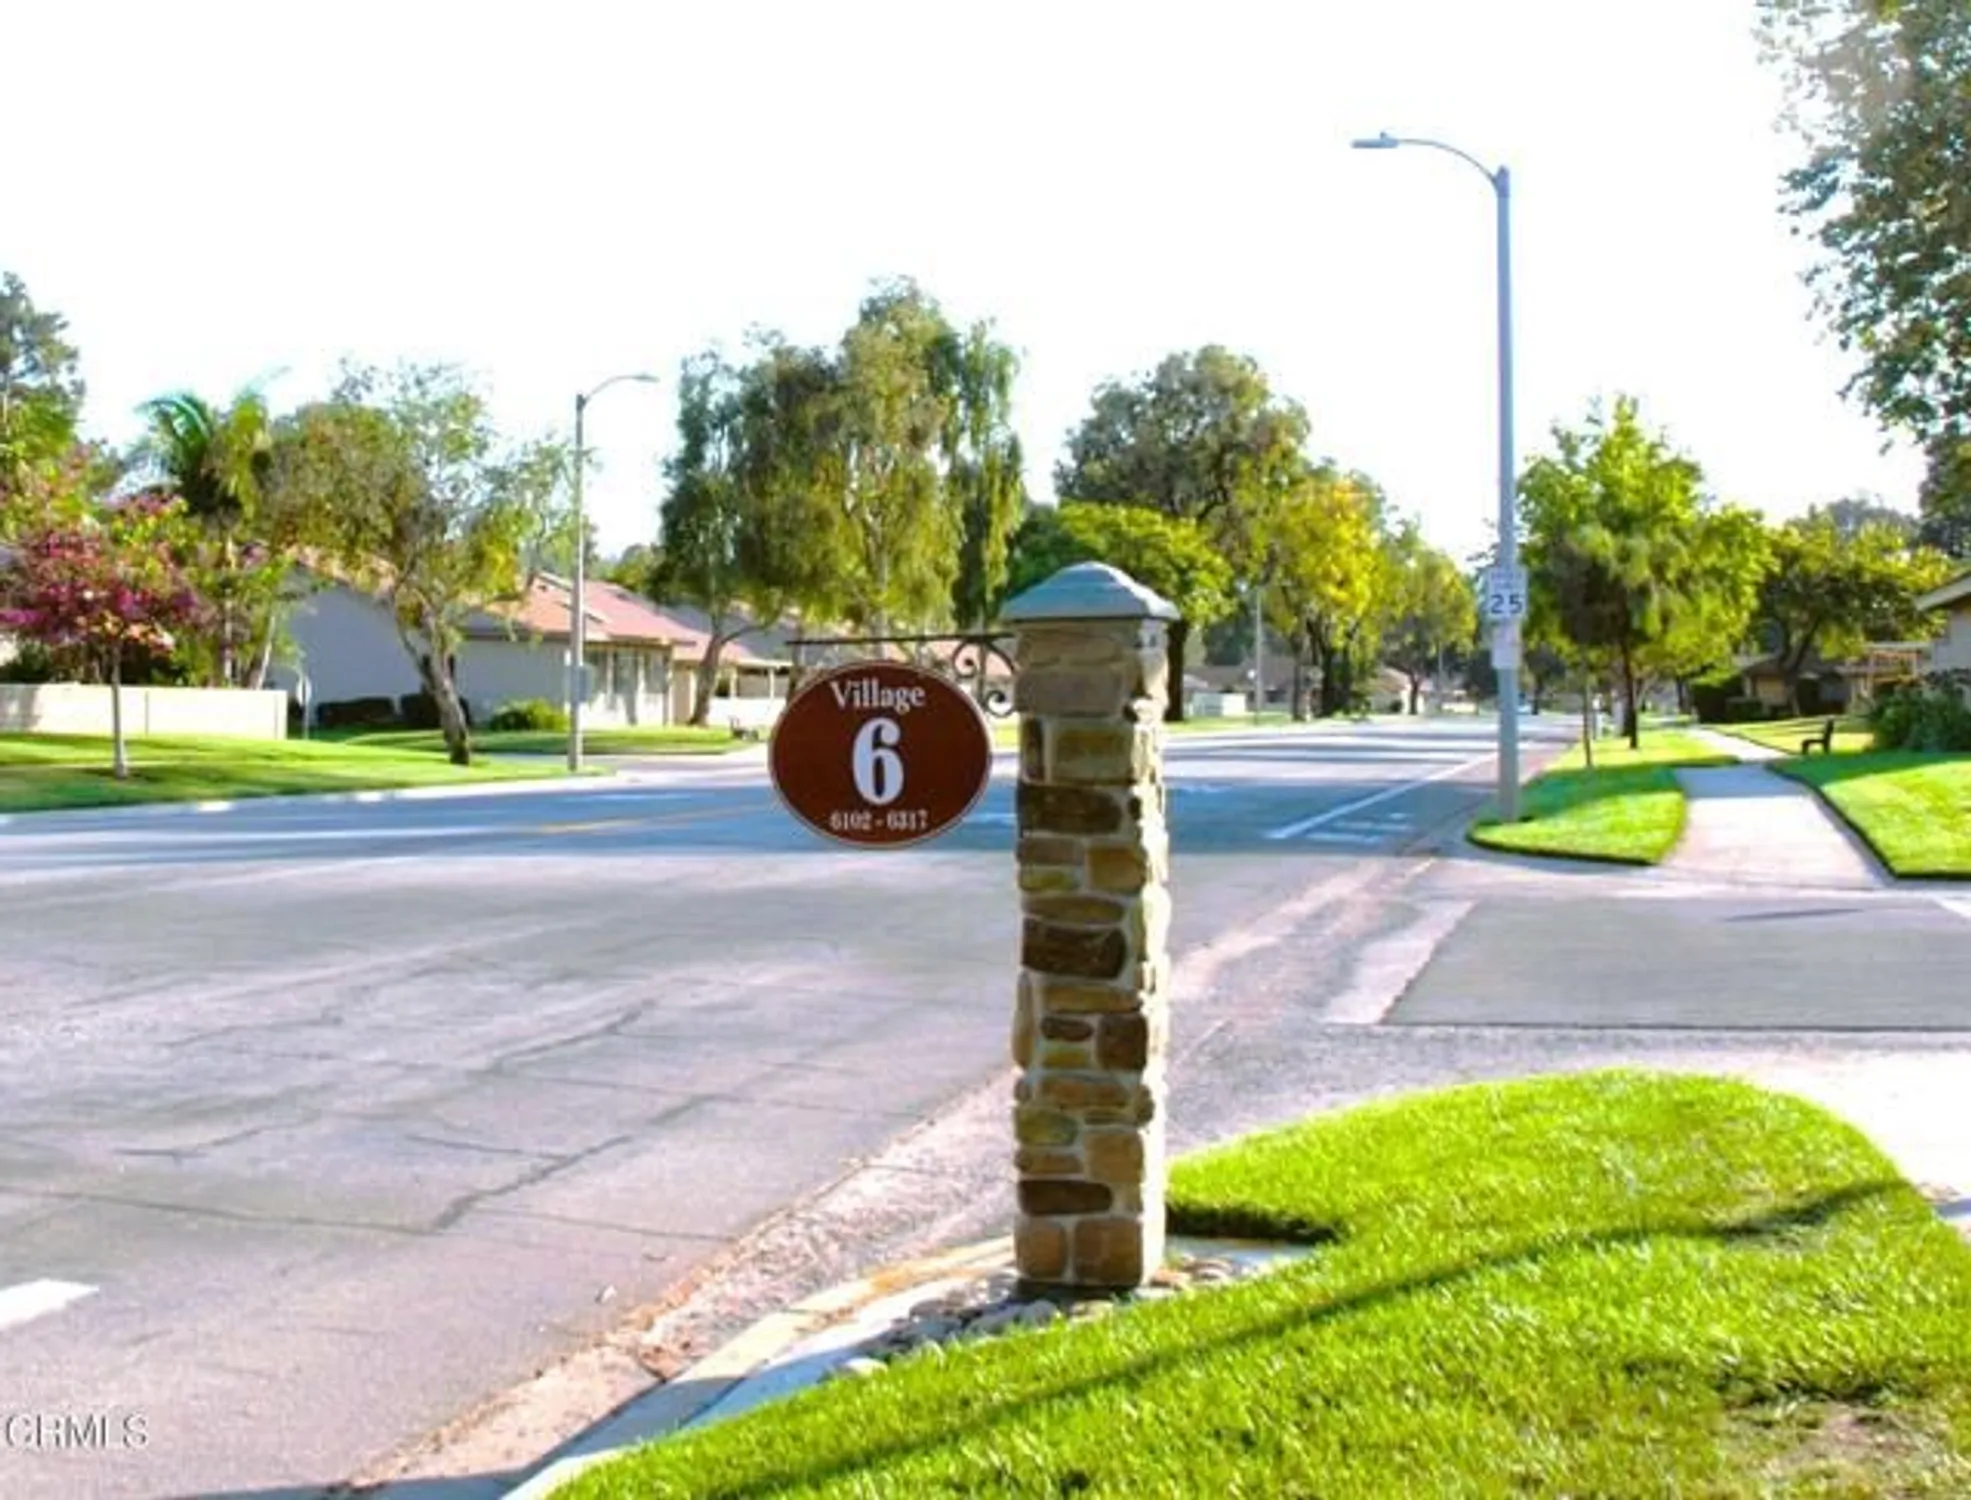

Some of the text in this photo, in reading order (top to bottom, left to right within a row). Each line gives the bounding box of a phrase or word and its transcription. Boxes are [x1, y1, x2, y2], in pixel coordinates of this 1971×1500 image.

[1490, 594, 1522, 614] 25
[829, 678, 925, 714] Village
[852, 717, 904, 805] 6
